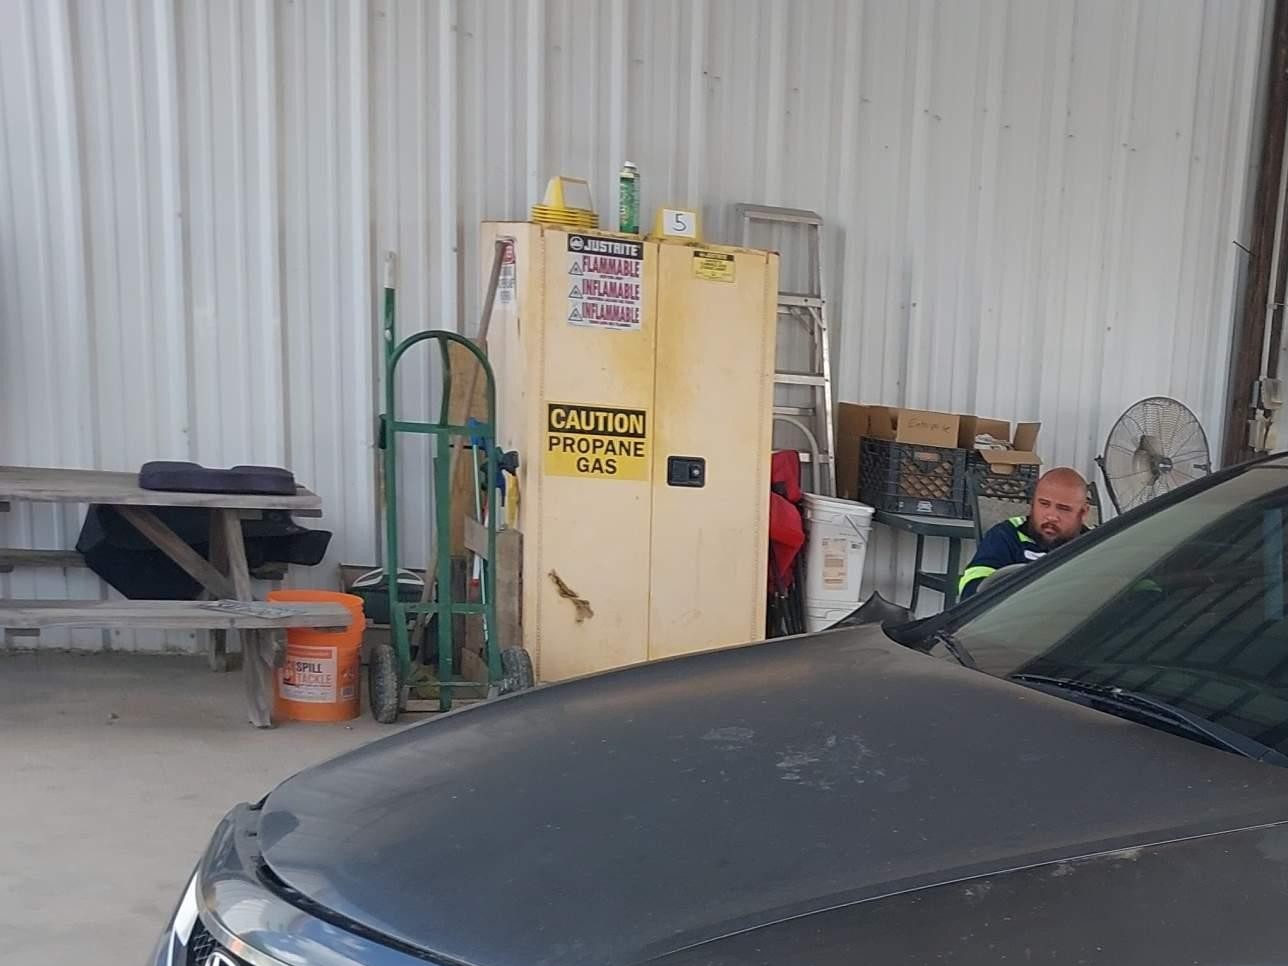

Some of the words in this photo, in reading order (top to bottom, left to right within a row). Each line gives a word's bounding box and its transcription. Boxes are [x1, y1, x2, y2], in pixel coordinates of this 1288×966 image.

[672, 213, 688, 232] 5
[584, 240, 640, 256] JUSTRITE
[582, 254, 641, 278] FLAMMABLE
[581, 278, 641, 301] INFLAMABLE
[581, 301, 641, 324] INFLAMMABLE
[550, 408, 644, 434] CAUTION
[548, 435, 645, 457] PROPANE
[576, 456, 617, 475] GAS
[296, 661, 322, 673] SPILL
[296, 673, 332, 684] TACKLE
